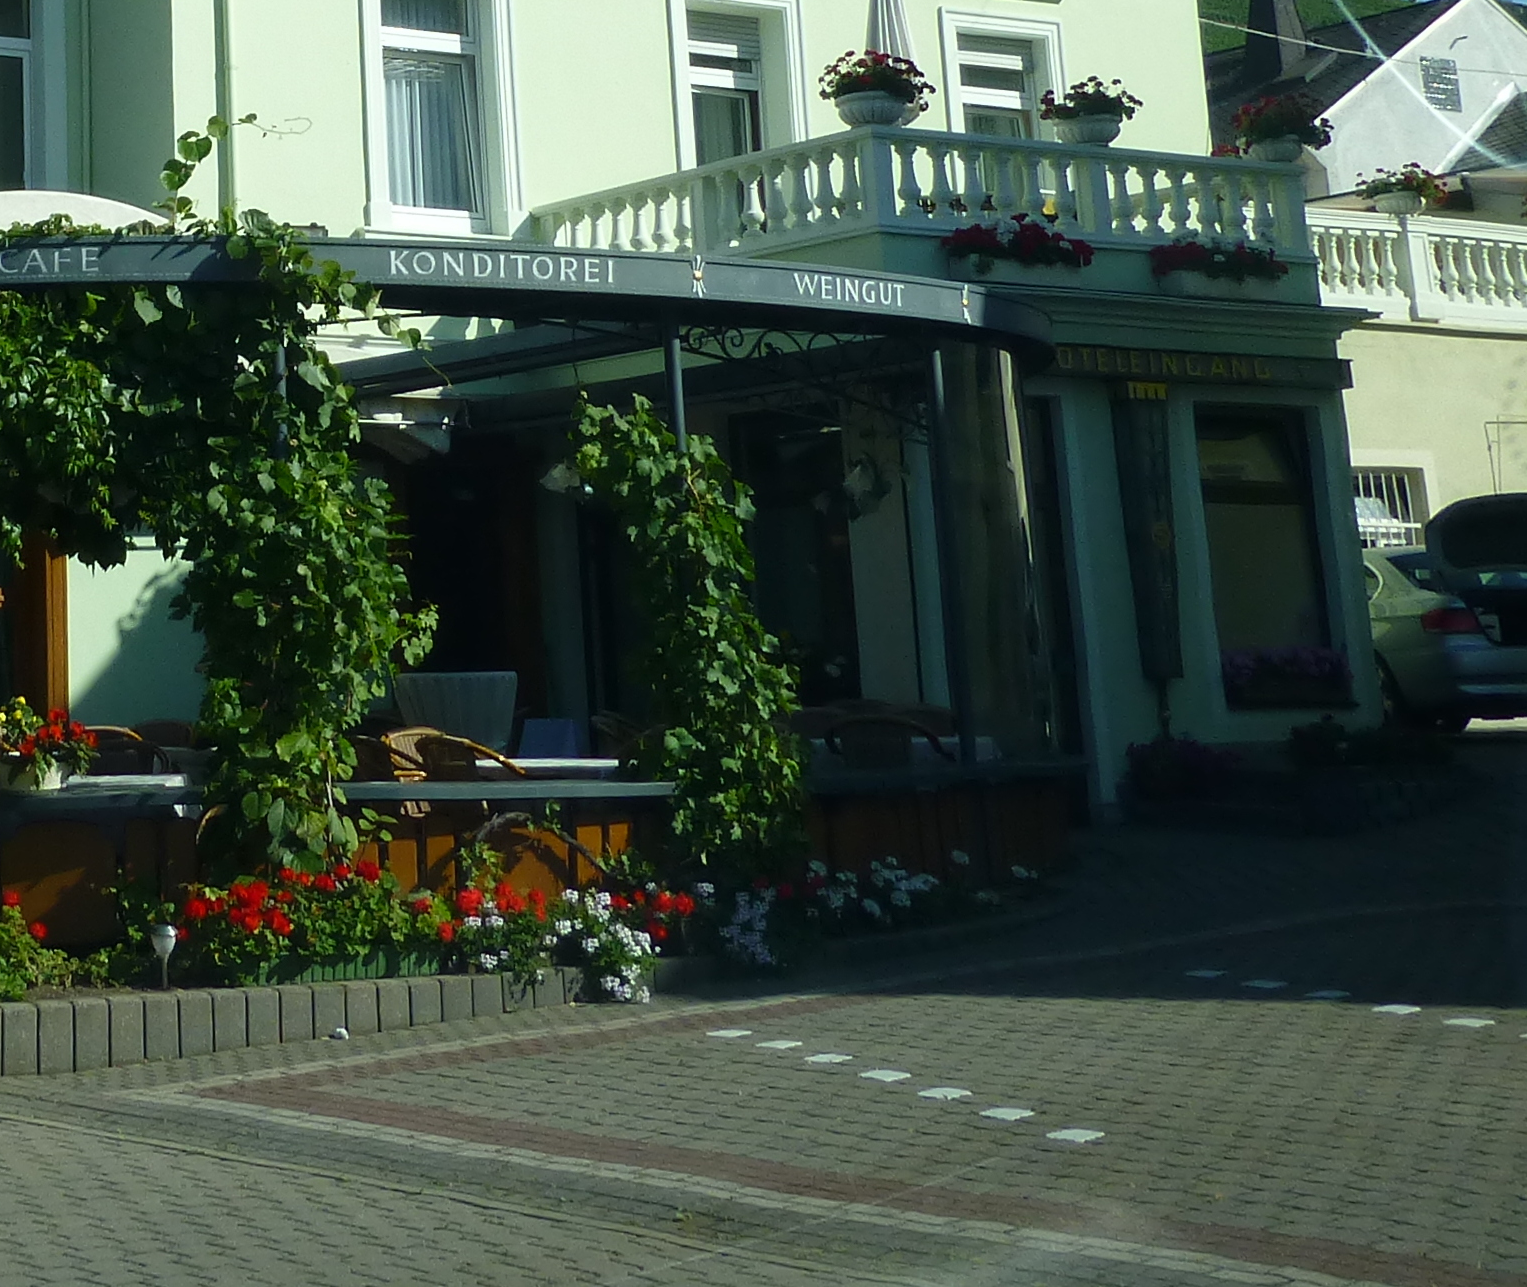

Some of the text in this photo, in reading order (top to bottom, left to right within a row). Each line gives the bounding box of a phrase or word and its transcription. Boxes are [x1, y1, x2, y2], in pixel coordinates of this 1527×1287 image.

[389, 249, 616, 285] KONDITOREI
[793, 272, 905, 308] WEINGUT
[1056, 346, 1272, 379] OTELEINGANG
